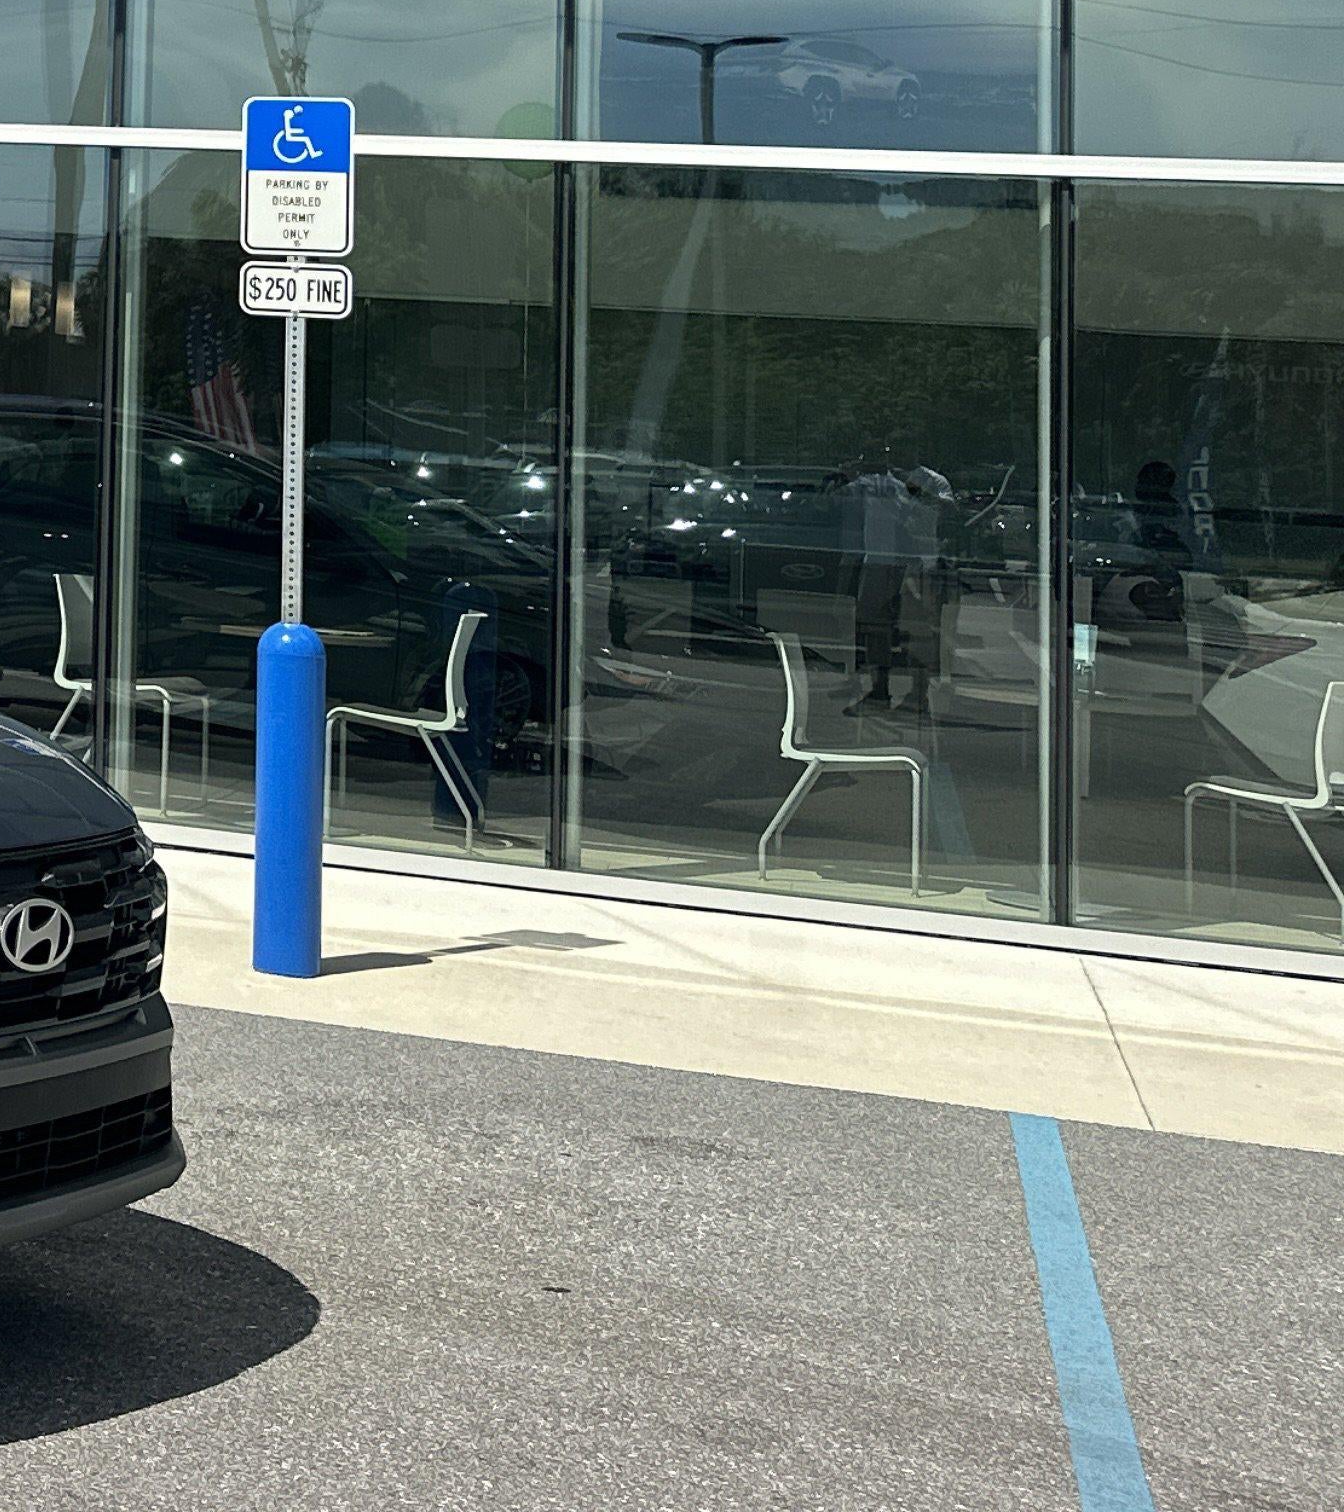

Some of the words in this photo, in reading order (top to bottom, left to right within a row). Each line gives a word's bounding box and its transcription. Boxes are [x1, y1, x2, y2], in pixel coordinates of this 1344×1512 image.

[266, 178, 310, 191] PARKING
[315, 179, 329, 191] BY
[272, 195, 322, 208] DISABLED
[278, 212, 316, 224] PERMIT
[282, 228, 310, 240] ONLY
[248, 274, 297, 302] $250
[307, 279, 343, 304] FINE
